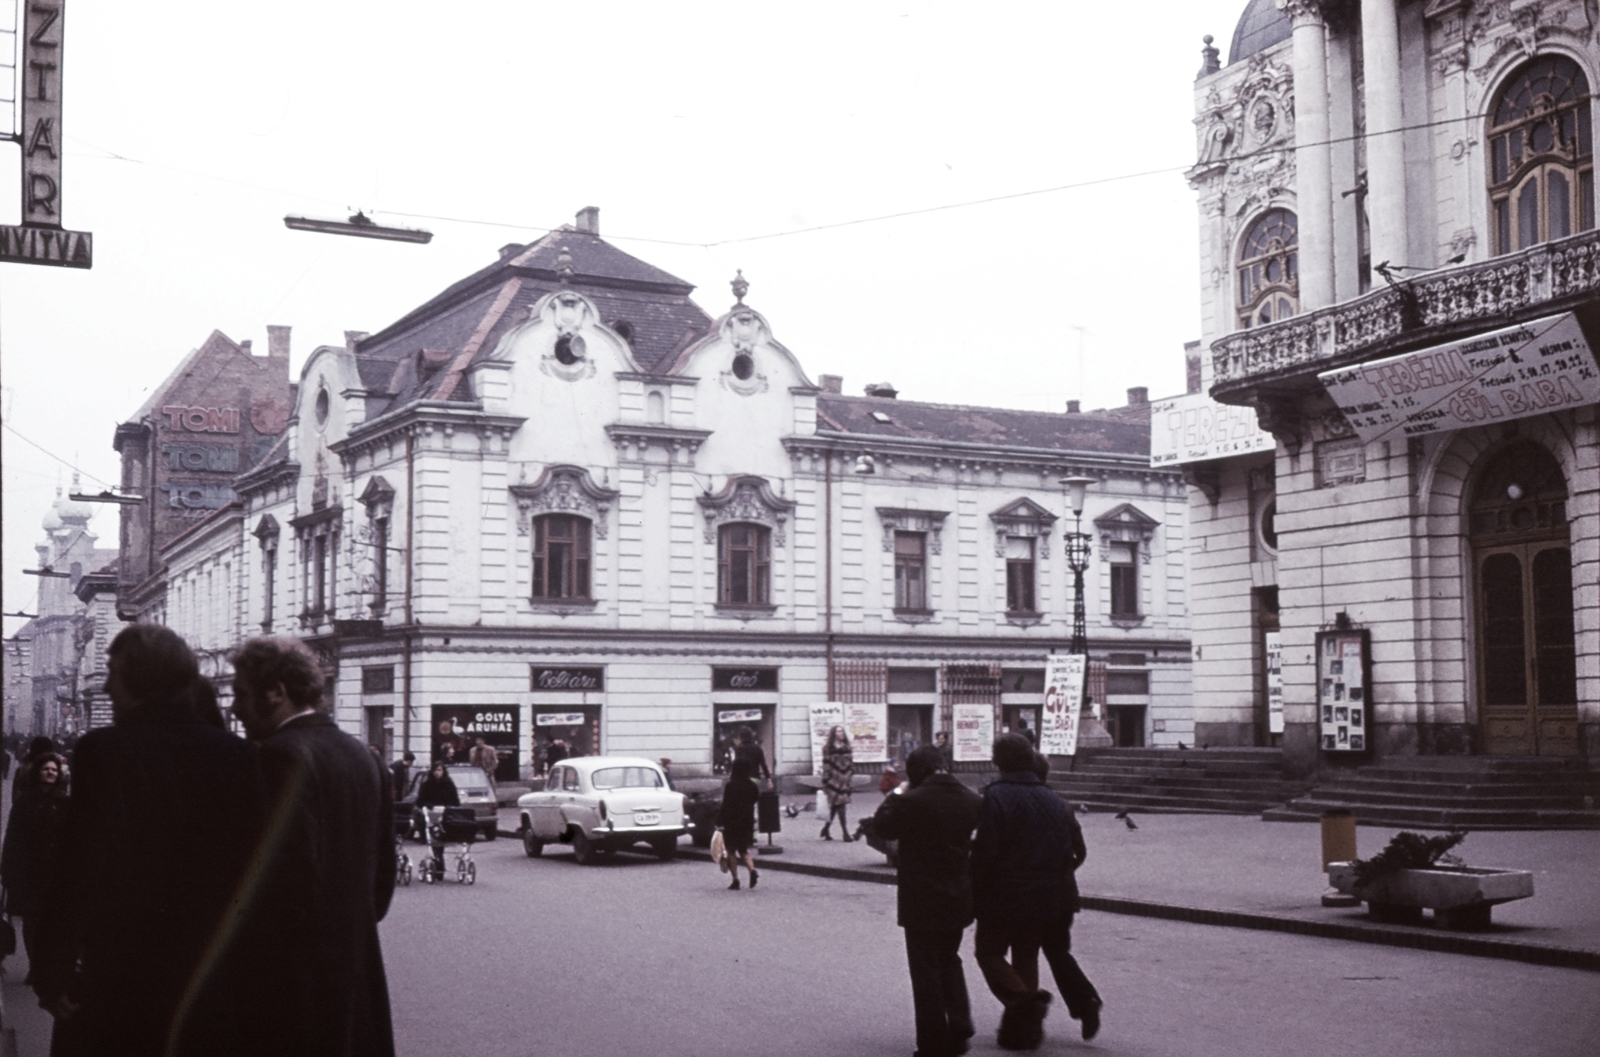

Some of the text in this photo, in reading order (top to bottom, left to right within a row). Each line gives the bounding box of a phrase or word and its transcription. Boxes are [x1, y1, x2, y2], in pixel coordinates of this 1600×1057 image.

[1361, 349, 1476, 398] TERÉZIA
[1449, 375, 1584, 423] GÜL BABA
[163, 405, 240, 433] TOMI
[162, 443, 239, 473] TOMI
